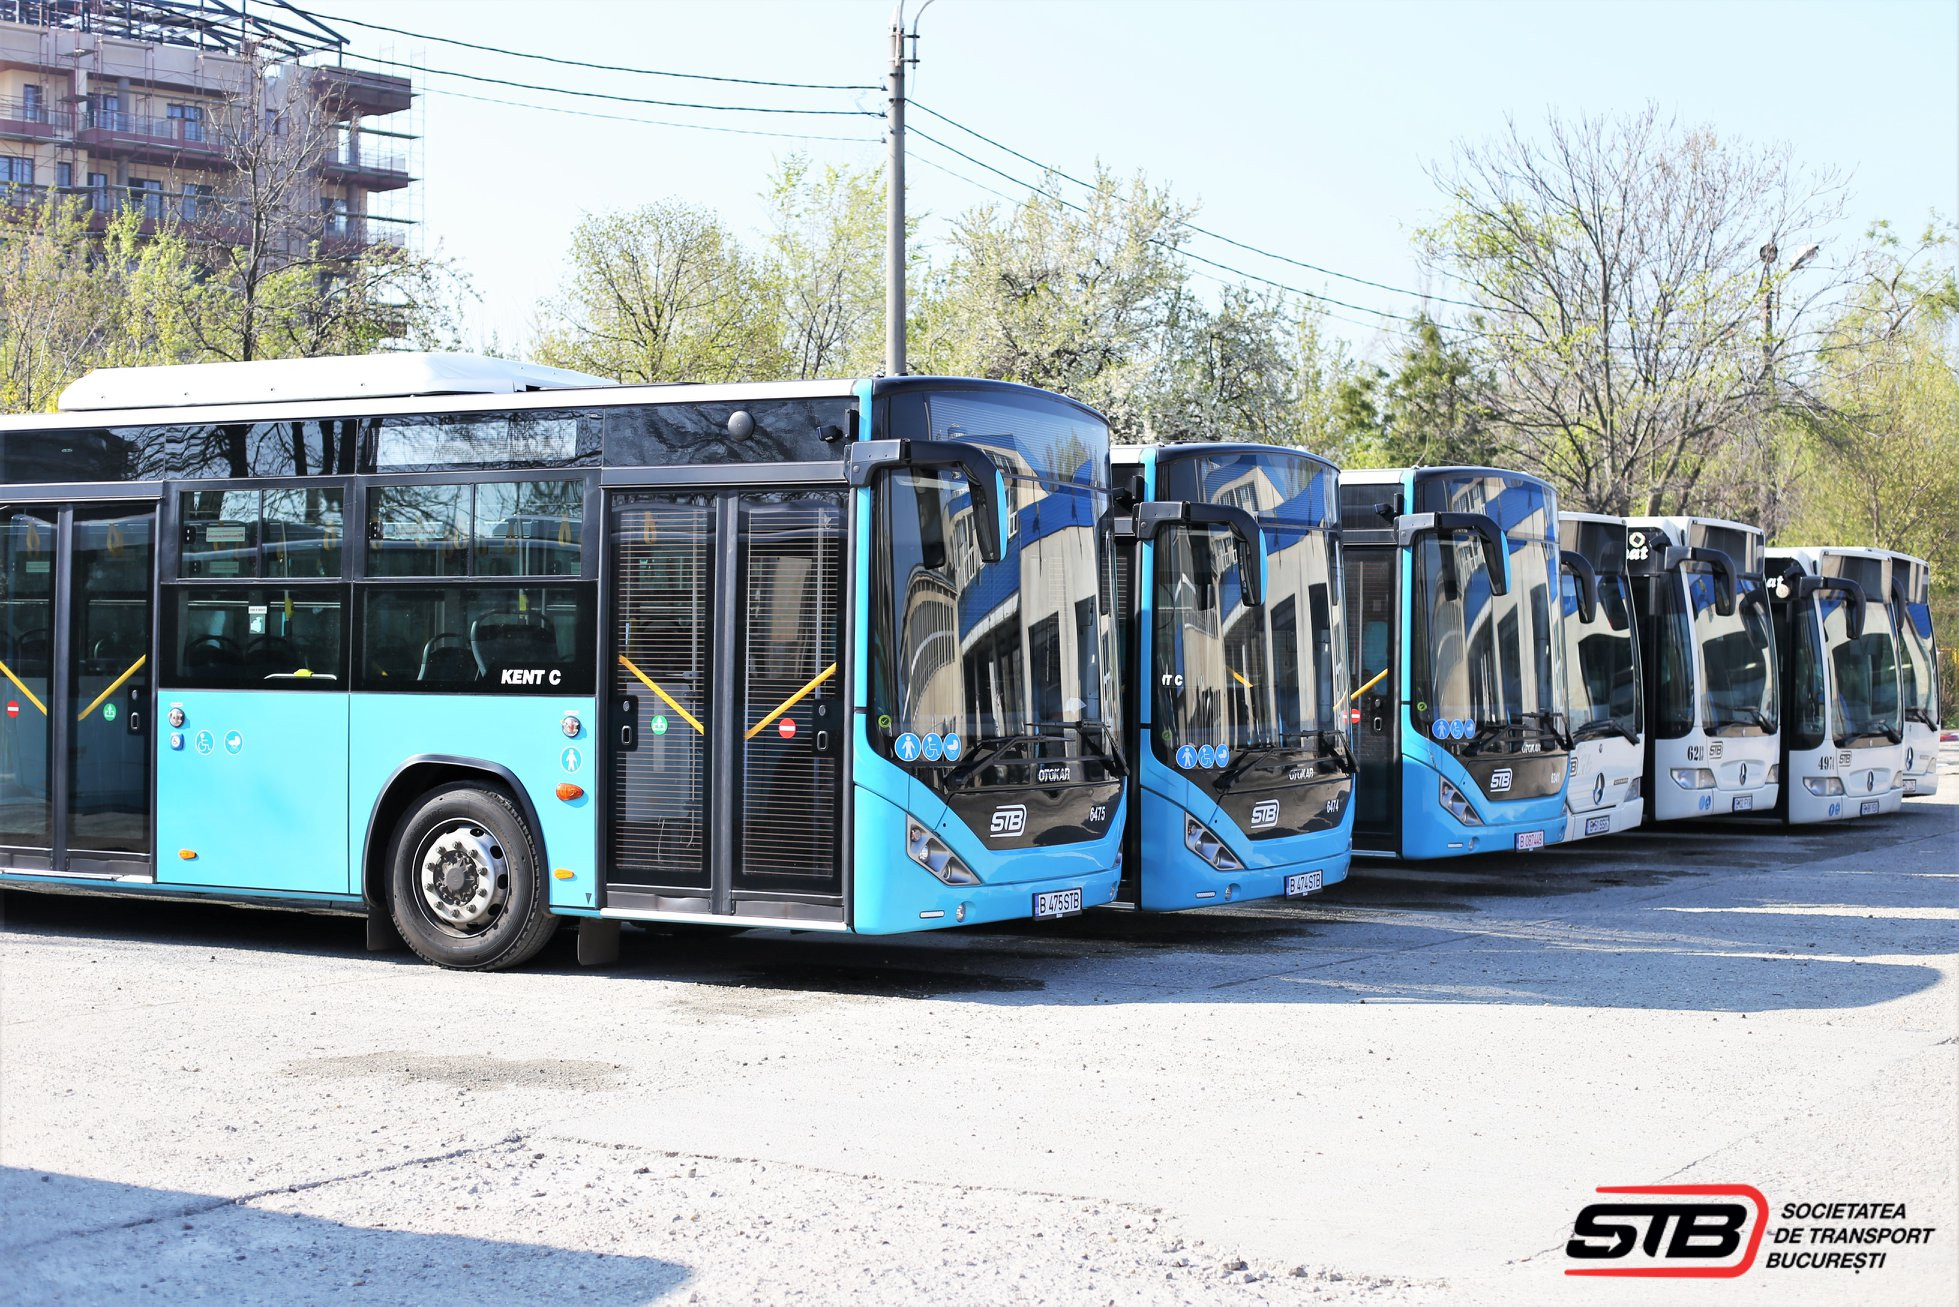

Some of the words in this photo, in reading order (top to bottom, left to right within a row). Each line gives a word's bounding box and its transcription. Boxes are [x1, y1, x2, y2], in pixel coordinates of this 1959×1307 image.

[501, 669, 545, 685] KENT
[548, 669, 561, 686] C
[1038, 767, 1071, 782] OTOKAR
[1326, 799, 1339, 813] 6474
[1089, 806, 1106, 822] 6475
